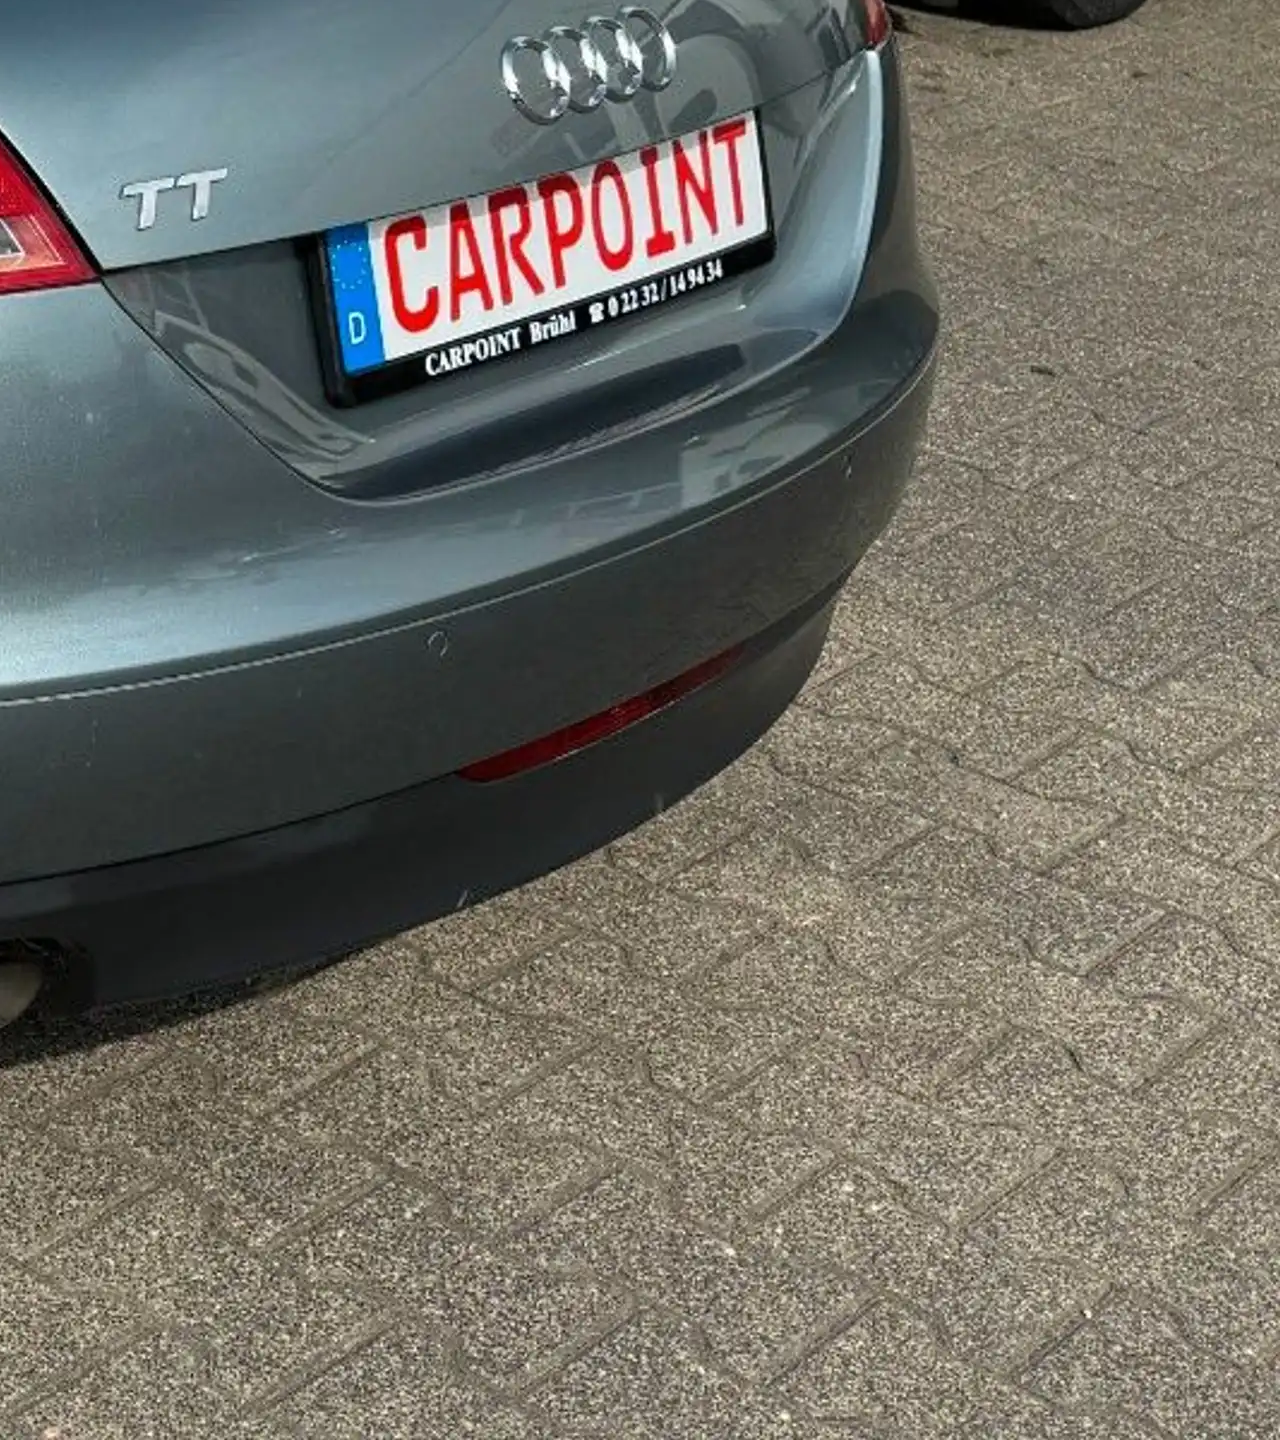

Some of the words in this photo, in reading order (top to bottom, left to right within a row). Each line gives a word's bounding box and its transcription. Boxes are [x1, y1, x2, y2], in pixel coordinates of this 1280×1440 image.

[121, 167, 228, 230] TT
[383, 117, 747, 334] CARPOINT
[348, 311, 368, 345] D
[424, 326, 522, 376] CARPOINT
[529, 309, 577, 344] Brühl
